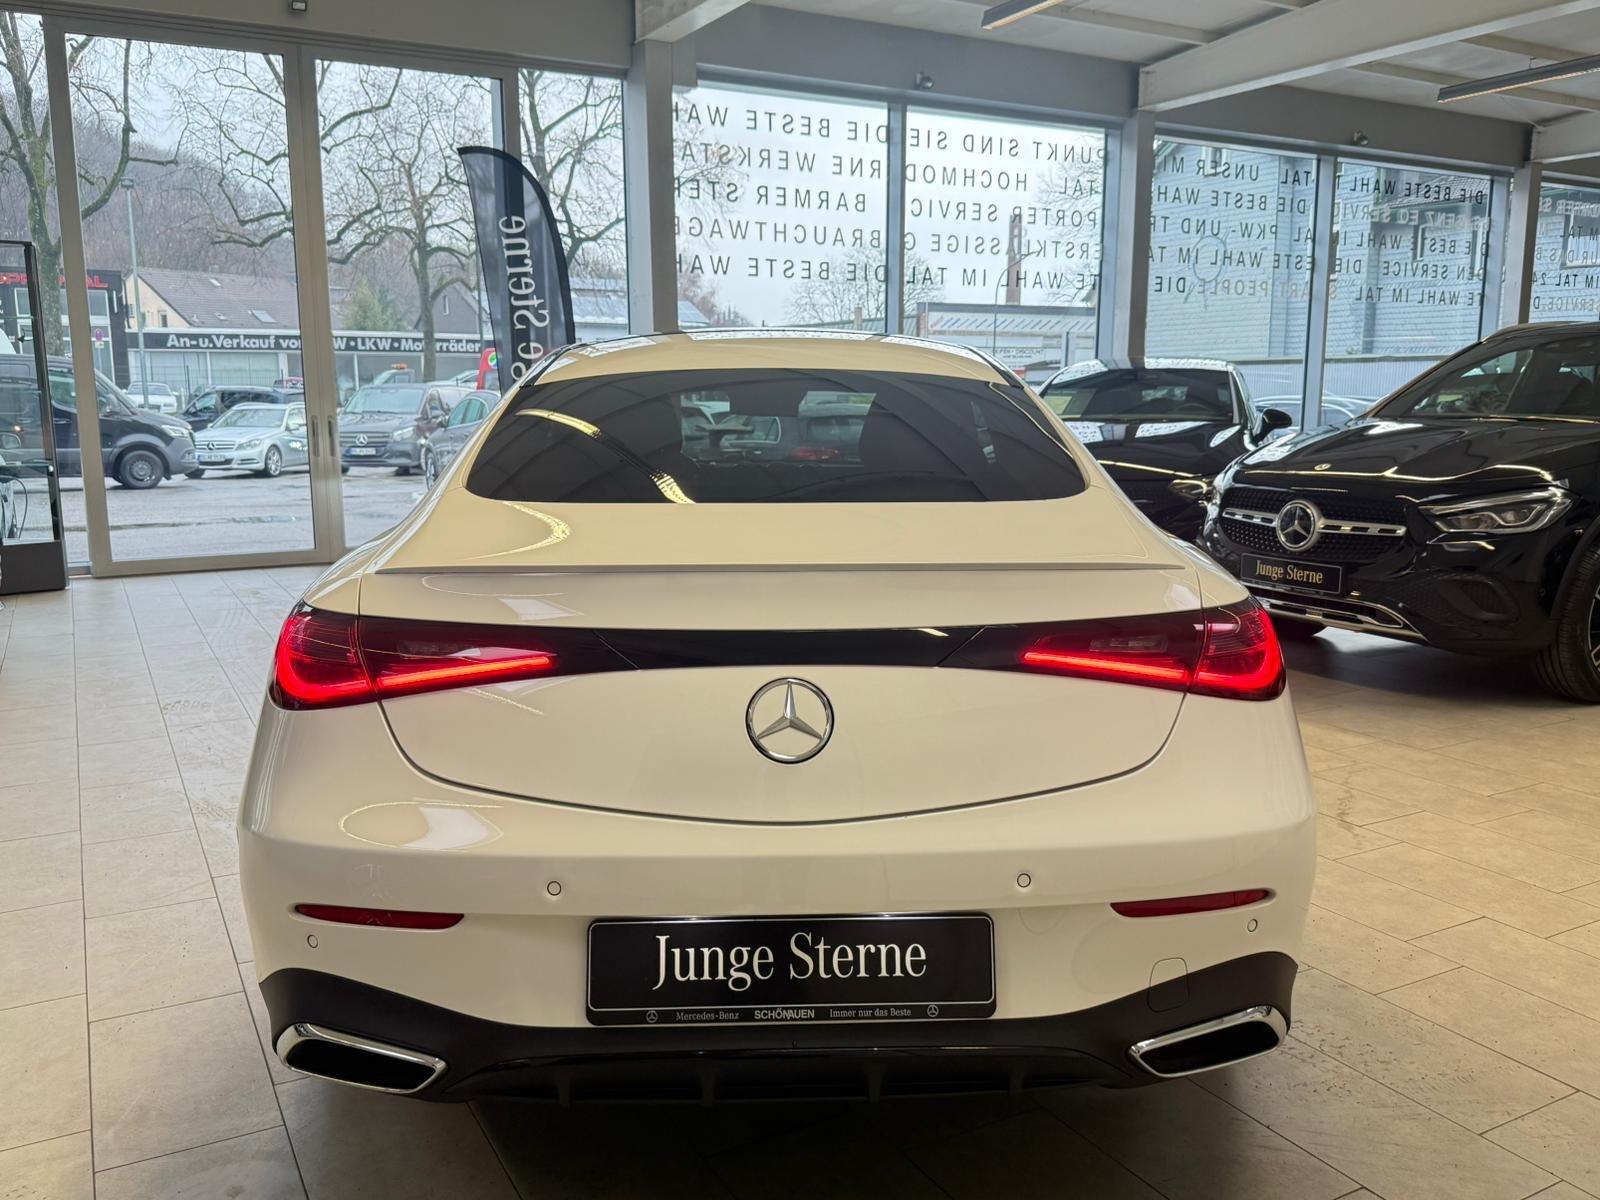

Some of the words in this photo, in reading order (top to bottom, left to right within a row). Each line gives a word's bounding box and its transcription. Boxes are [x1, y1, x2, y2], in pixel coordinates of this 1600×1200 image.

[357, 337, 391, 351] LKW
[400, 338, 481, 352] Morräder
[1256, 560, 1284, 580] Junge
[1287, 565, 1323, 584] Sterne
[652, 935, 774, 991] Junge
[789, 932, 927, 980] Sterne
[676, 1011, 740, 1021] Mercedes-Benz
[754, 1008, 815, 1020] SCHÖNAUEN
[830, 1008, 856, 1018] Immer
[858, 1008, 873, 1017] nur
[874, 1007, 888, 1017] das
[890, 1007, 912, 1017] Beste
